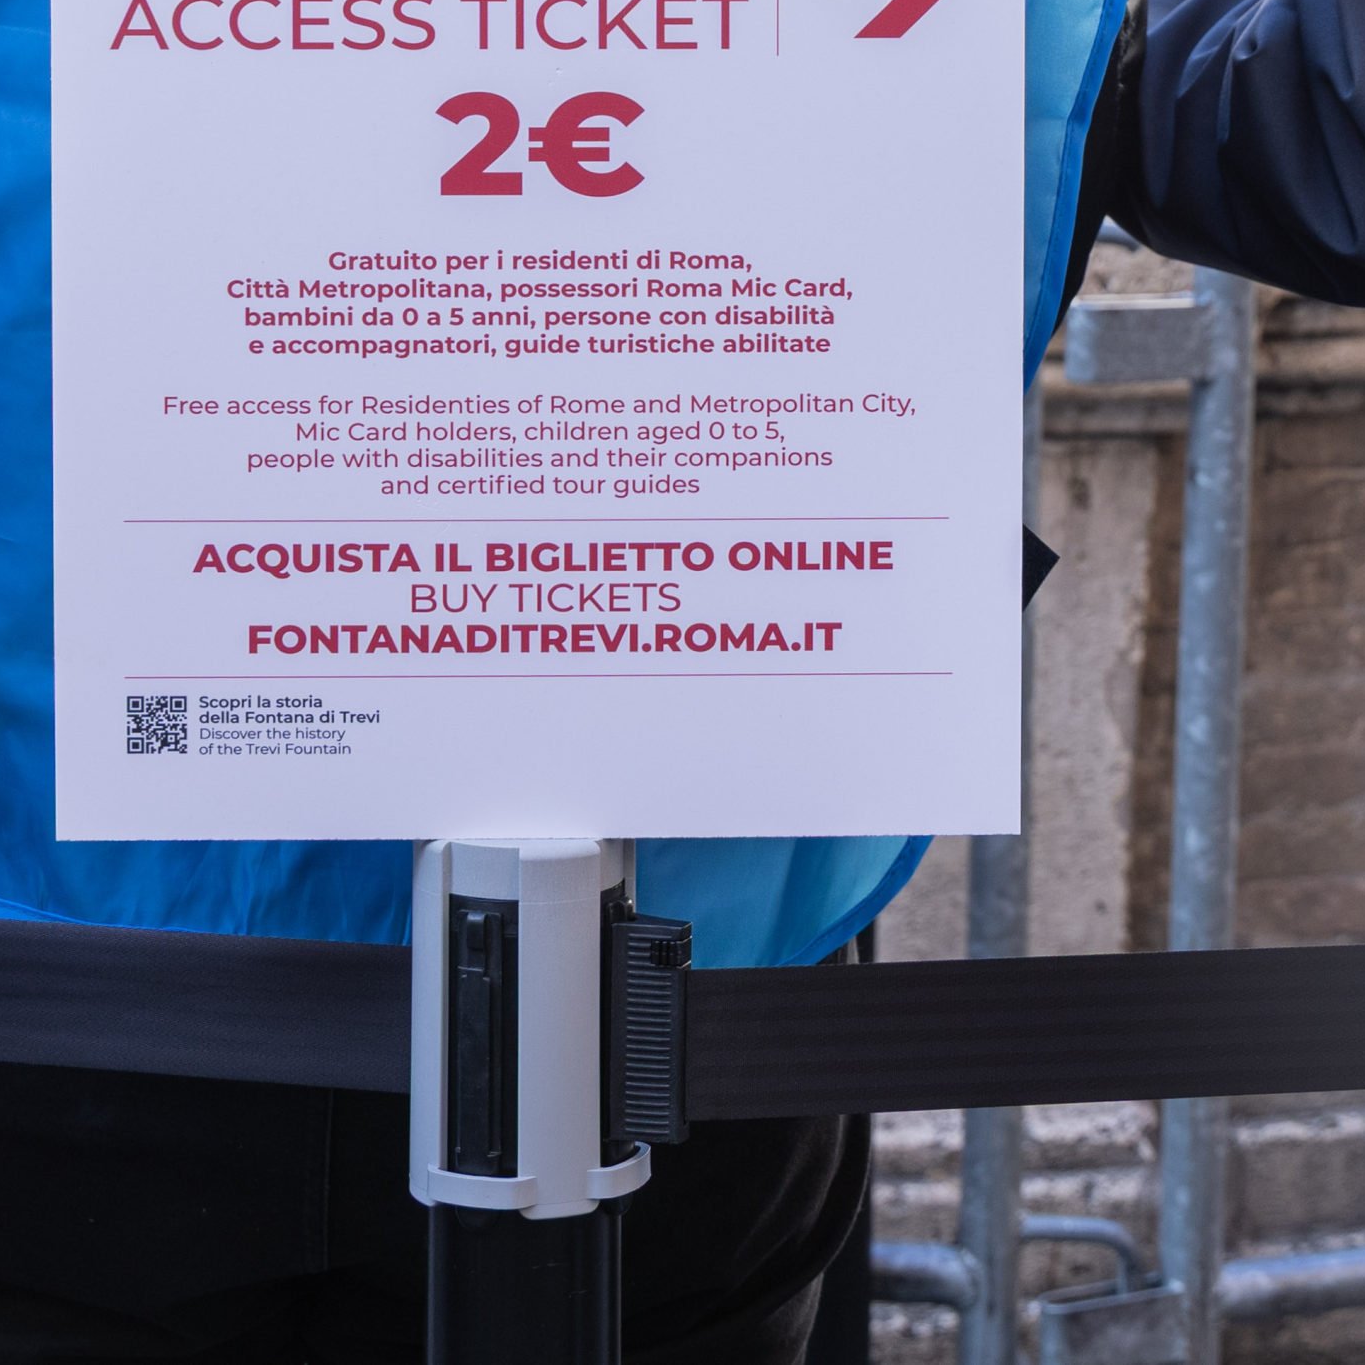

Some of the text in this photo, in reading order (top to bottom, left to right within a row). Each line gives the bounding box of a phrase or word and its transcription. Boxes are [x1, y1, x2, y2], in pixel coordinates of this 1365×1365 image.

[434, 91, 646, 198] 2€
[328, 248, 753, 275] Gratuito per i residenti di Roma,
[226, 276, 853, 304] Città Metropolitana, possessori Roma Mic Card,
[244, 304, 835, 331] bambini da 0 a 5 anni, persone con disabilità
[248, 332, 831, 359] e accompagnatori, guide turistiche abilitate
[163, 392, 916, 418] Free access for Residenties of Rome and Metropolitan City,
[296, 420, 785, 446] Mic Card holders, children aged 0 to 5,
[247, 446, 833, 473] people with disabilities and their companions
[380, 473, 700, 499] and certified tour guides
[192, 540, 894, 580] ACQUISTA IL BIGLIETTO ONLINE
[411, 582, 682, 614] BUY TICKETS
[248, 621, 843, 655] FONTANADITREVI.ROMA.IT
[198, 694, 323, 711] Scopri la storia
[198, 710, 380, 724] della Fontana di Trevi
[199, 726, 346, 742] Discover the history
[198, 742, 352, 756] of the Trevi Fountain
